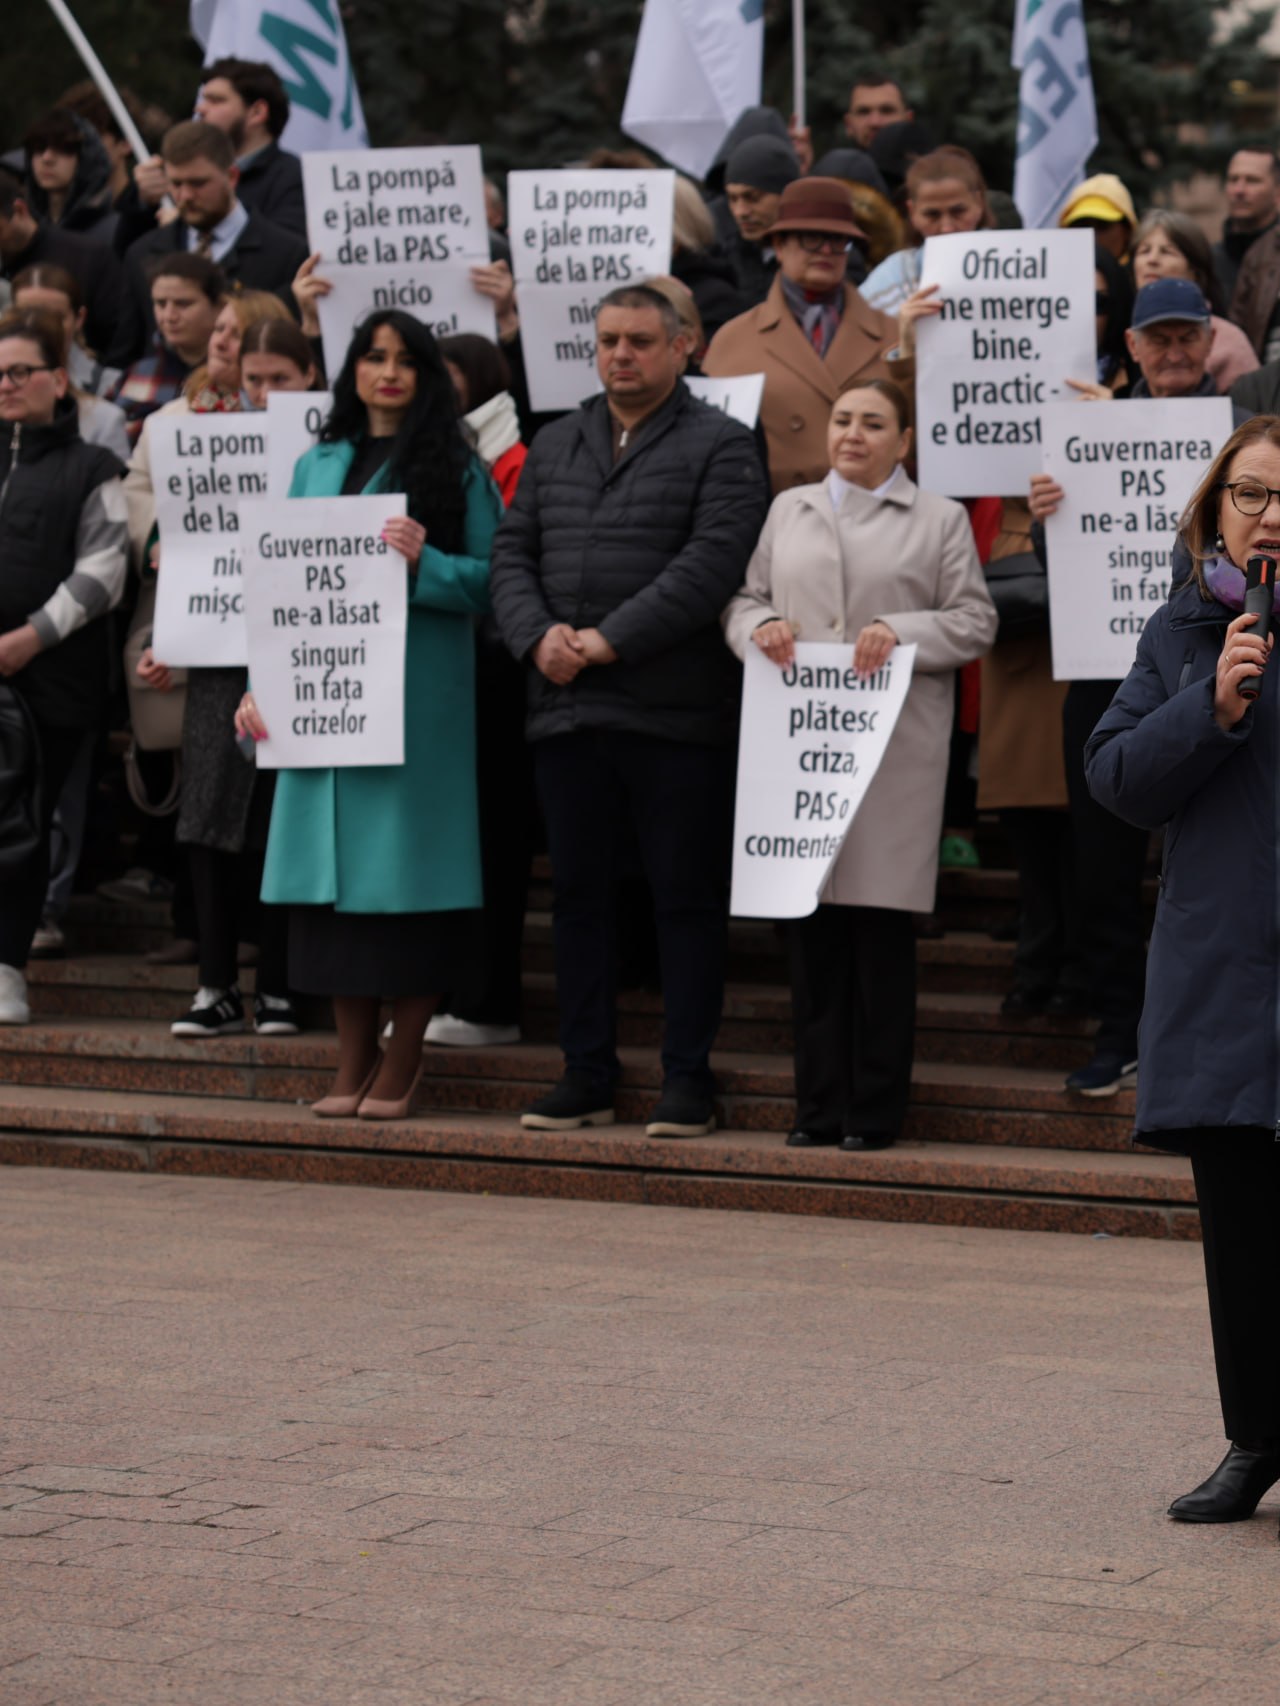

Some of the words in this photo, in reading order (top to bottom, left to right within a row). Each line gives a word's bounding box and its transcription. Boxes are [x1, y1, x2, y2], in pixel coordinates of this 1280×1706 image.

[332, 165, 360, 192] La
[368, 161, 456, 197] pompă
[534, 184, 557, 210] La
[565, 184, 647, 215] pompă
[324, 209, 338, 229] e
[343, 201, 390, 234] jale
[398, 204, 470, 227] mare,
[338, 240, 368, 264] de
[375, 237, 397, 263] la
[404, 234, 449, 262] PAS
[524, 229, 536, 248] e
[542, 221, 582, 252] jale
[588, 228, 656, 248] mare,
[536, 258, 562, 283] de
[568, 257, 587, 282] la
[593, 255, 631, 281] PAS
[963, 247, 1047, 280] Oficial
[374, 278, 432, 307] nicio
[941, 297, 972, 320] ne
[981, 296, 1069, 328] merge
[953, 374, 1044, 413] practic
[932, 423, 947, 445] e
[956, 413, 1041, 445] dezast
[176, 429, 202, 456] La
[210, 433, 264, 462] pom
[1065, 437, 1213, 463] Guvernarea
[168, 475, 181, 495] e
[188, 468, 231, 501] jale
[1121, 469, 1166, 497] PAS
[183, 506, 212, 532] de
[219, 506, 239, 531] la
[1081, 512, 1138, 533] ne-a
[1146, 504, 1179, 532] lăs
[259, 532, 388, 558] Guvernarea
[1108, 545, 1172, 574] singur
[306, 565, 346, 592] PAS
[188, 587, 244, 622] mișc
[273, 605, 322, 626] ne-a
[329, 598, 380, 625] lăsat
[1109, 611, 1145, 635] criz
[291, 639, 365, 674] singuri
[295, 676, 315, 701] în
[292, 708, 366, 735] crizelor
[790, 700, 879, 738] plătesc
[799, 743, 859, 778] criza,
[795, 790, 838, 820] PAS
[839, 799, 849, 820] o
